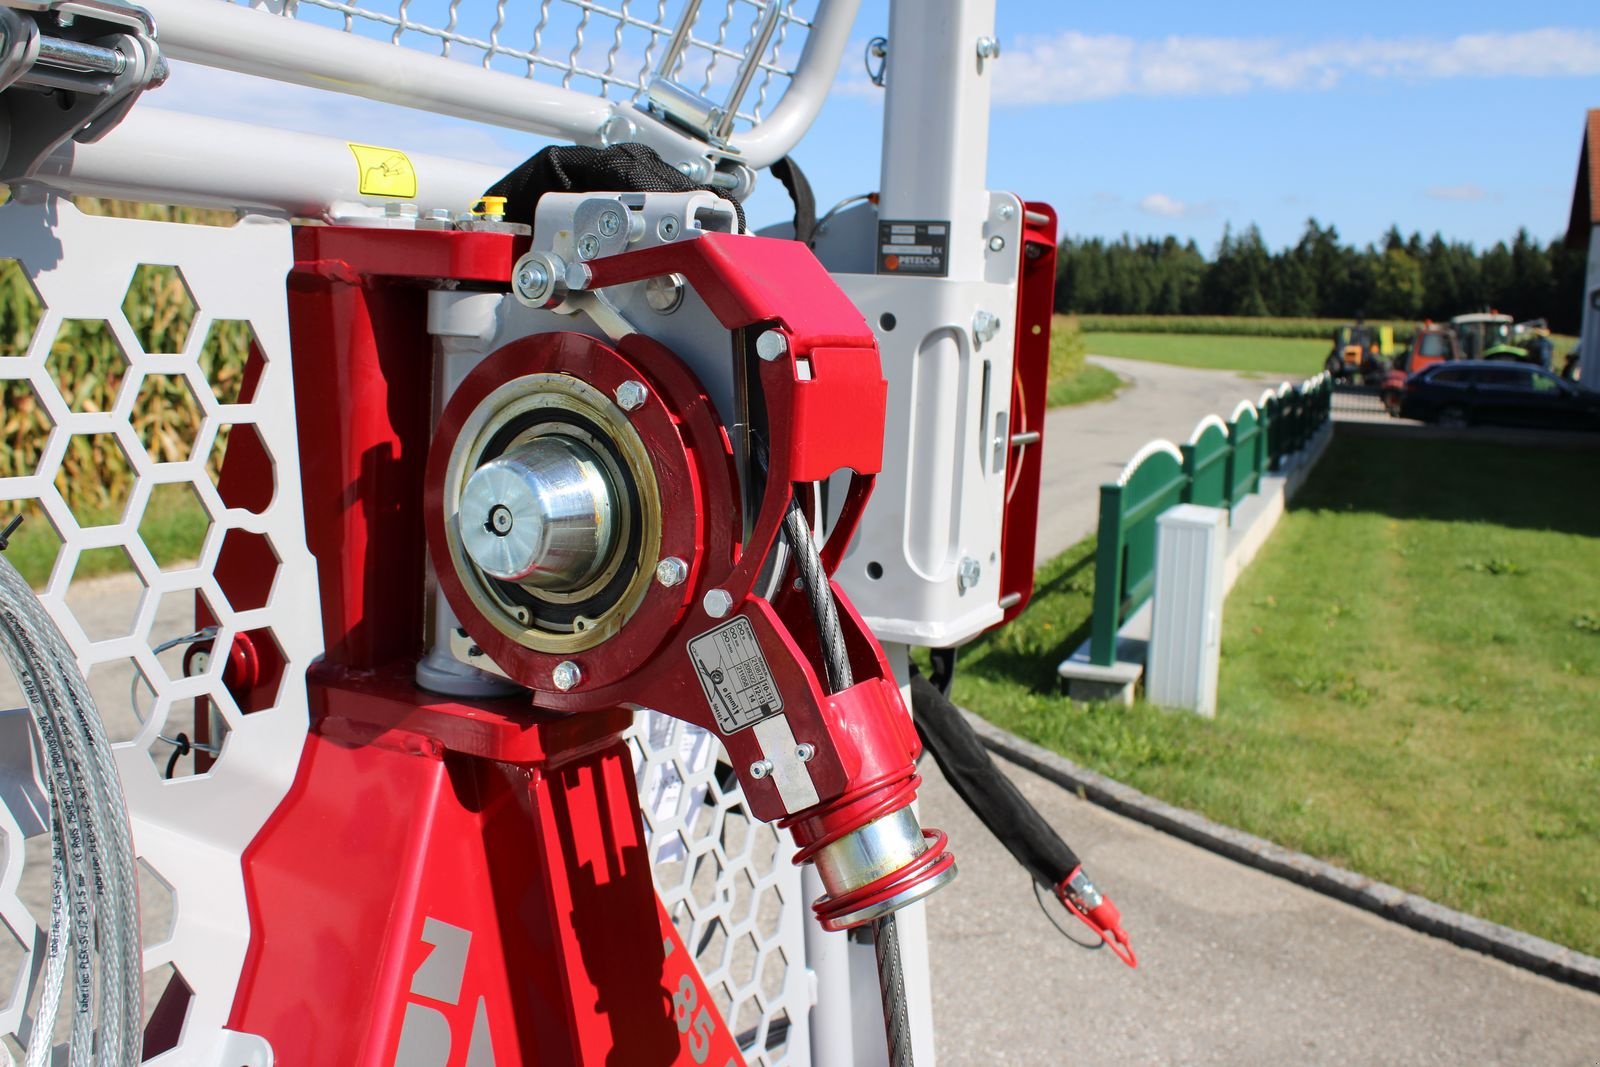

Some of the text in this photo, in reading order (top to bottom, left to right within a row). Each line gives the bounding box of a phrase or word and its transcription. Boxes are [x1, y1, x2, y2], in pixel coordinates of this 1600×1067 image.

[751, 659, 765, 681] 210874
[761, 682, 773, 700] 10-11
[724, 692, 739, 711] [mm]
[748, 694, 756, 703] 14
[754, 685, 766, 704] 12-13
[80, 973, 90, 1013] kabeltec
[672, 973, 717, 1065] 85
